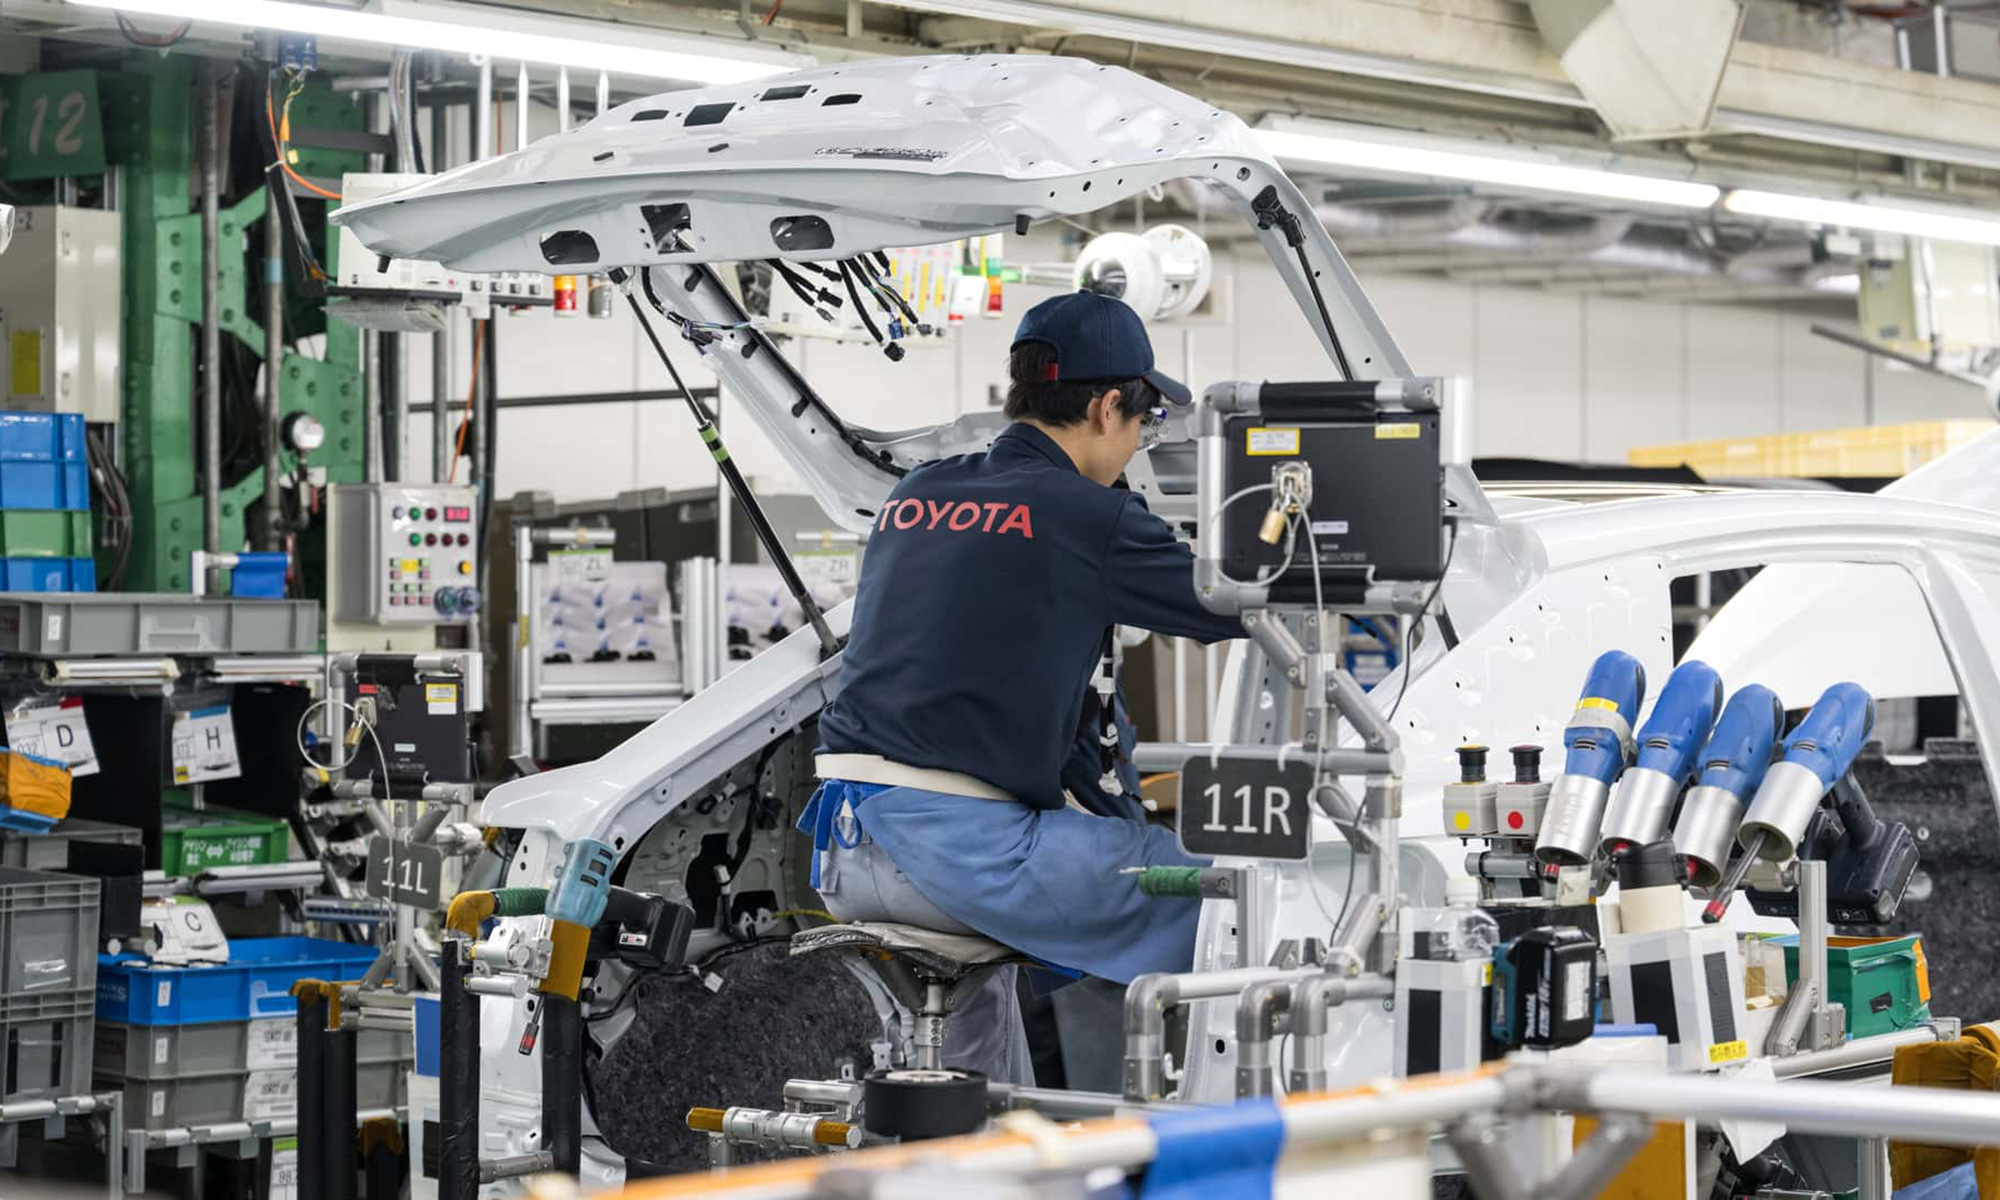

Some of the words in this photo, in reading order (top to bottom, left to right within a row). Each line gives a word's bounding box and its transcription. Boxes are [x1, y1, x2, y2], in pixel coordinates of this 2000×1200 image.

[29, 91, 86, 157] 12
[878, 498, 1034, 539] TOYOTA
[56, 724, 74, 748] D
[205, 726, 221, 750] H
[1203, 783, 1292, 836] 11R
[382, 857, 428, 894] 11L
[184, 911, 202, 932] C
